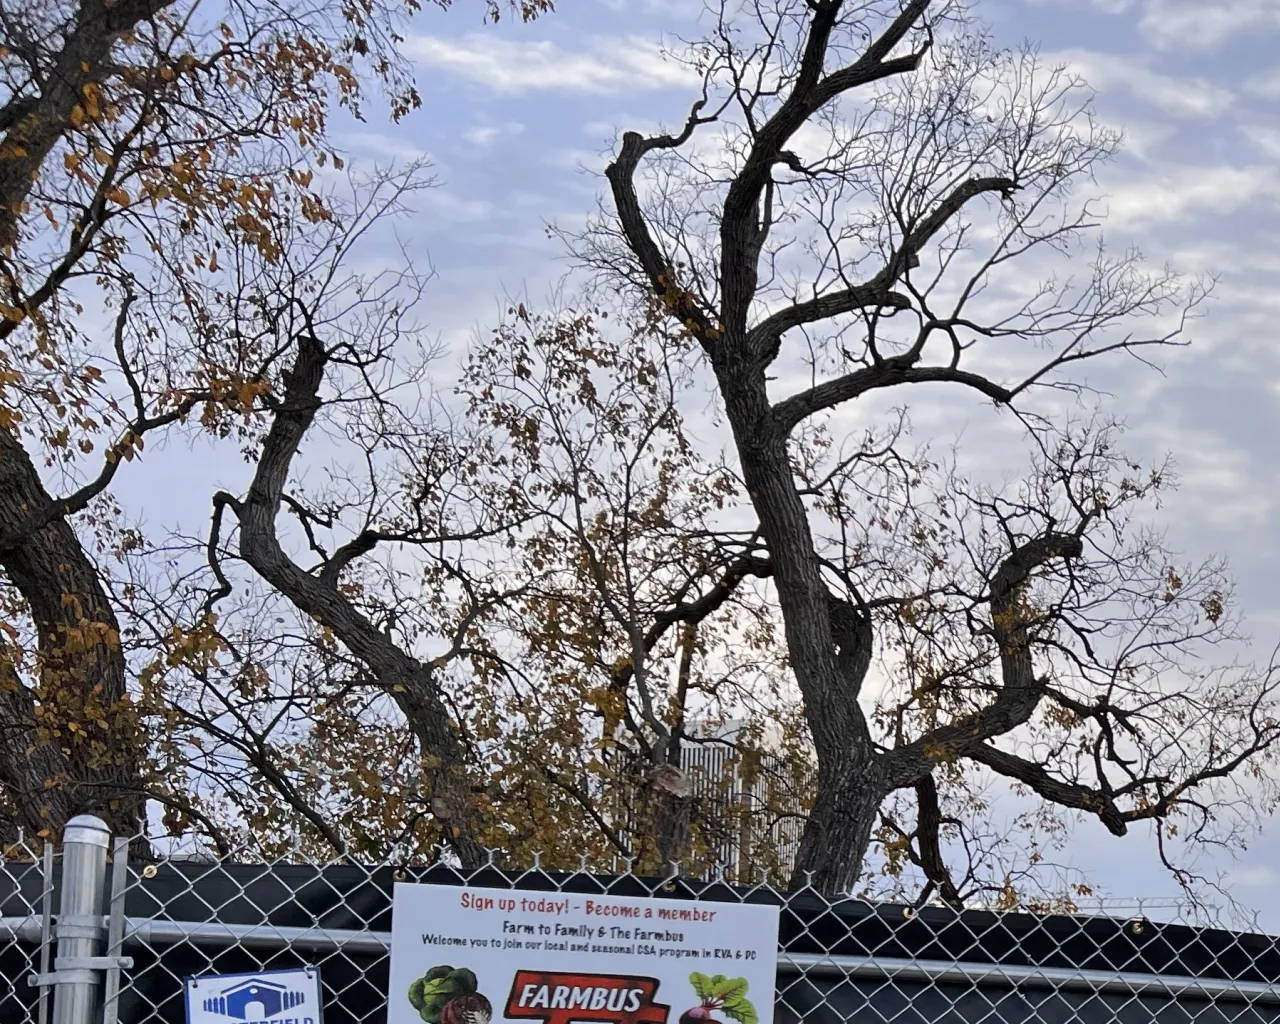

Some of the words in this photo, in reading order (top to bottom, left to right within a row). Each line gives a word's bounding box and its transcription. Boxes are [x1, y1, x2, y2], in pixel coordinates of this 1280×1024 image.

[461, 892, 494, 911] Sign
[499, 899, 516, 913] up
[520, 898, 569, 916] today!
[585, 900, 640, 918] Become
[644, 908, 653, 918] a
[658, 908, 717, 922] member
[503, 921, 534, 935] Farm
[538, 923, 551, 935] to
[555, 923, 594, 939] Family
[597, 927, 606, 938] &
[610, 926, 631, 939] The
[634, 928, 684, 942] Farmbus
[422, 934, 467, 946] Welcome
[470, 938, 487, 948] you
[490, 939, 501, 948] to
[503, 940, 522, 950] join
[525, 941, 542, 950] our
[544, 940, 568, 951] local
[571, 942, 589, 952] and
[592, 943, 635, 954] seasonal
[637, 945, 656, 956] CSA
[659, 948, 700, 960] program
[702, 948, 712, 958] in
[714, 949, 732, 959] RVA
[735, 951, 742, 959] &
[745, 951, 757, 960] DC
[518, 984, 644, 1012] FARMBUS
